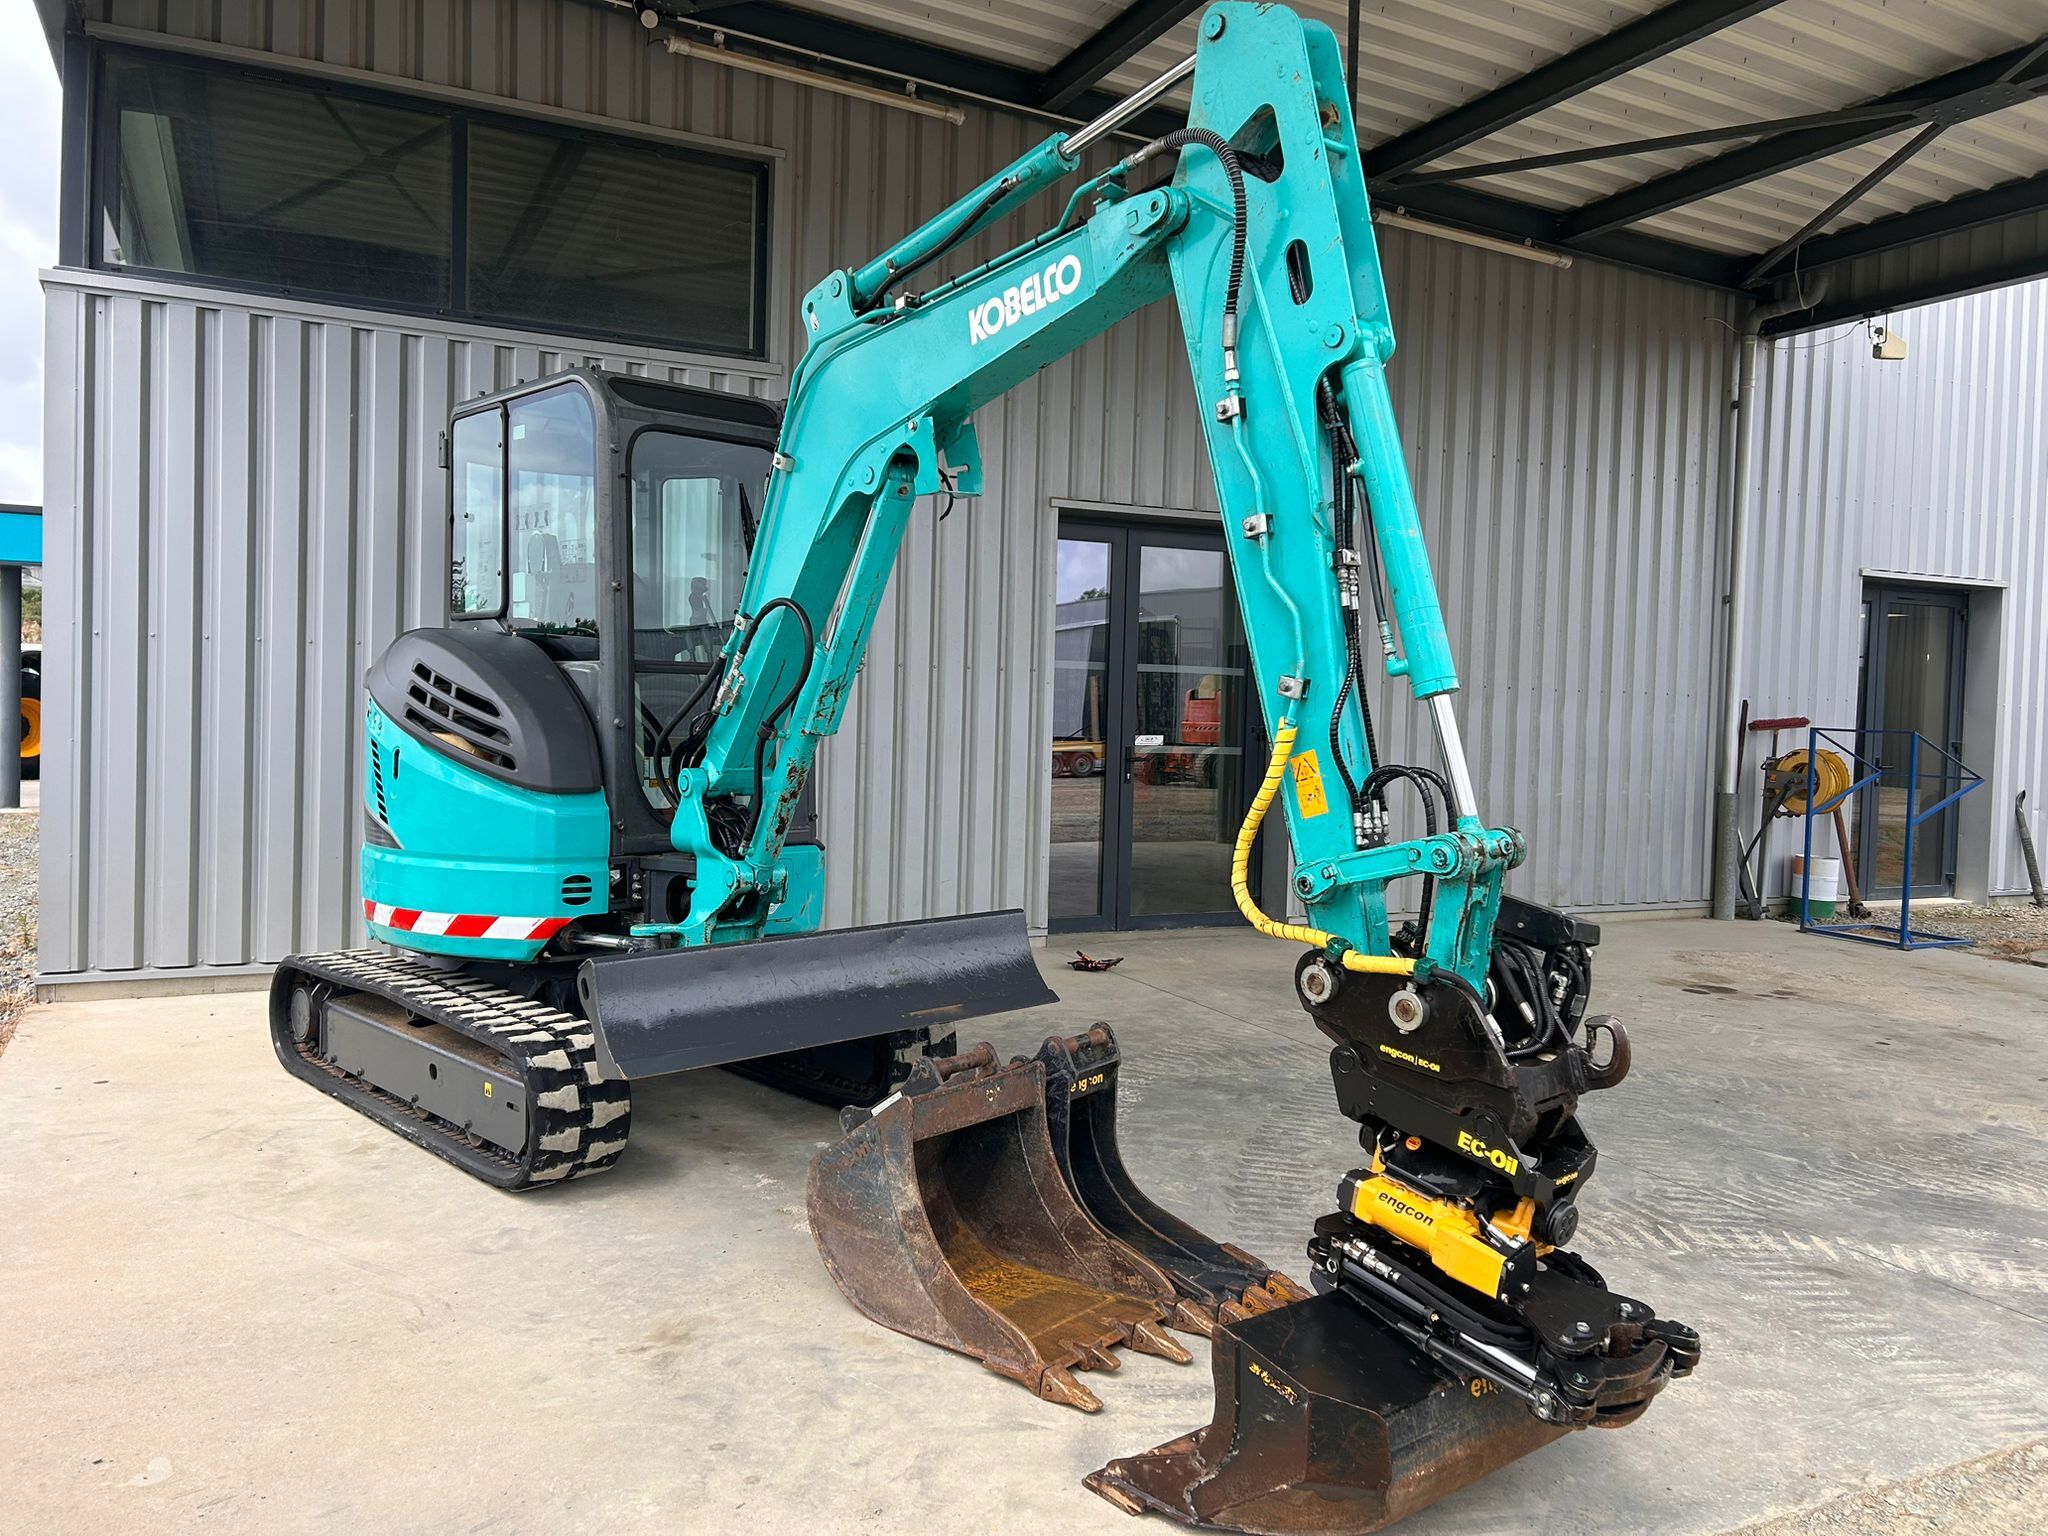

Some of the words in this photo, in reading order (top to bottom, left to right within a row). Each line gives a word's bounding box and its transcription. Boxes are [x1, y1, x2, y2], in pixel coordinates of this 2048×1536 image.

[968, 254, 1082, 346] KOBELCO
[1379, 1044, 1415, 1064] engcon
[1457, 1130, 1519, 1176] EC-Oil
[1378, 1192, 1434, 1227] engcon
